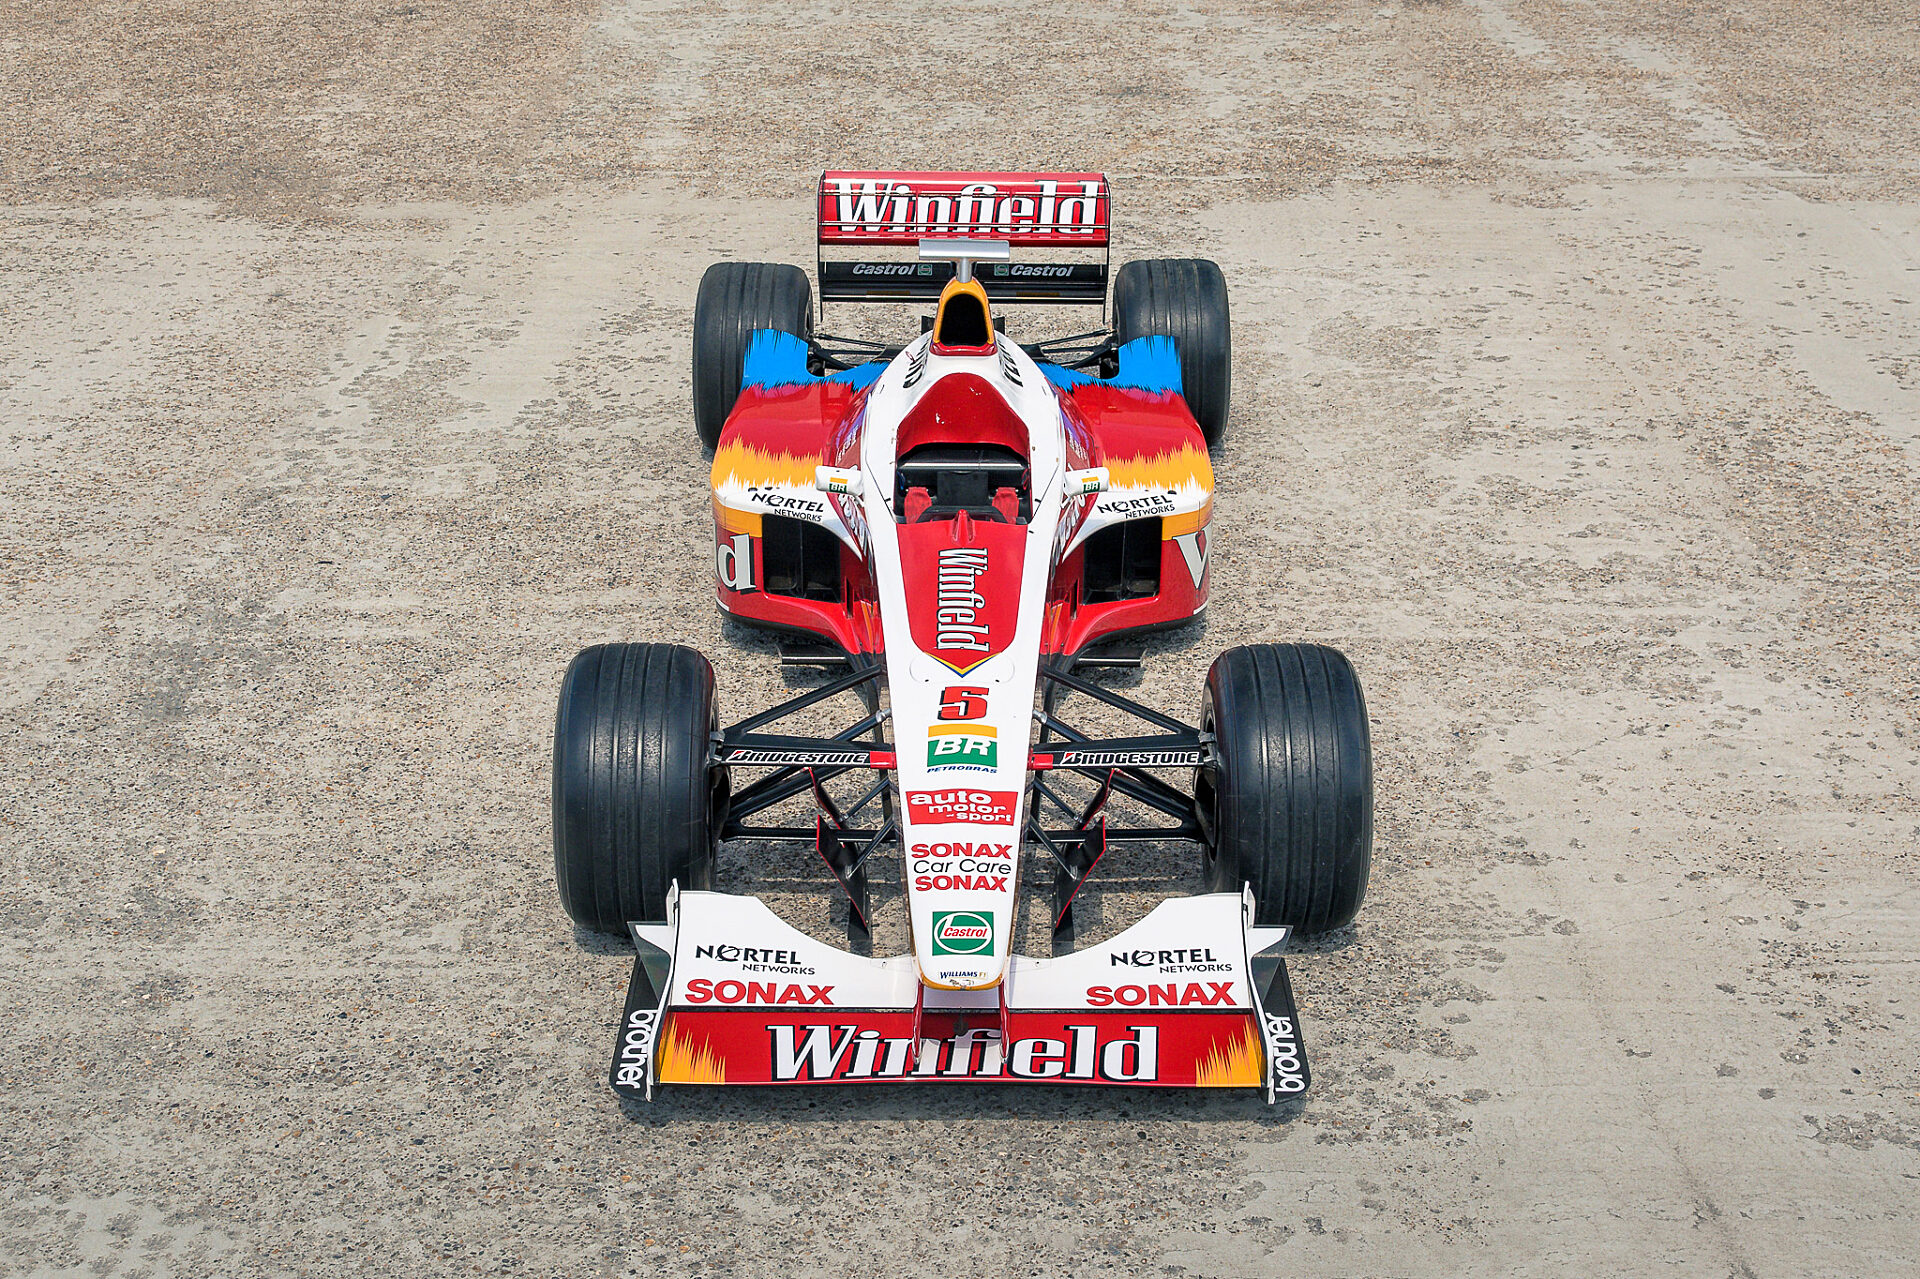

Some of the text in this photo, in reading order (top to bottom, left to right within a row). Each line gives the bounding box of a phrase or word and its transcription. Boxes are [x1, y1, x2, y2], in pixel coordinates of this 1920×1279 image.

[836, 178, 1100, 235] Winfield
[852, 263, 916, 275] Castrol
[1010, 264, 1074, 277] Castrol
[751, 492, 824, 513] NORTEL
[1096, 494, 1173, 515] NORTEL
[774, 508, 823, 522] NETWORKS
[1125, 503, 1176, 519] NETWORKS
[936, 547, 990, 652] Winfield
[937, 686, 990, 720] 5
[933, 738, 992, 756] BR
[727, 750, 870, 765] BRIDGESTONE
[1060, 751, 1200, 766] BRIDGESTONE
[926, 765, 998, 774] PETROBRAS
[910, 790, 992, 806] auto
[928, 803, 1007, 814] motor
[911, 842, 1013, 860] SONAX
[913, 859, 1012, 875] Car Care
[915, 875, 1008, 892] SONAX
[943, 927, 988, 938] Castrol
[695, 943, 802, 966] NORTEL
[1110, 948, 1217, 968] NORTEL
[742, 963, 816, 976] NETWORKS
[939, 971, 978, 979] WILLIAMS
[1159, 963, 1233, 974] NETWORKS
[685, 979, 835, 1005] SONAX
[1086, 982, 1238, 1006] SONAX
[766, 1025, 1159, 1082] Winfield
